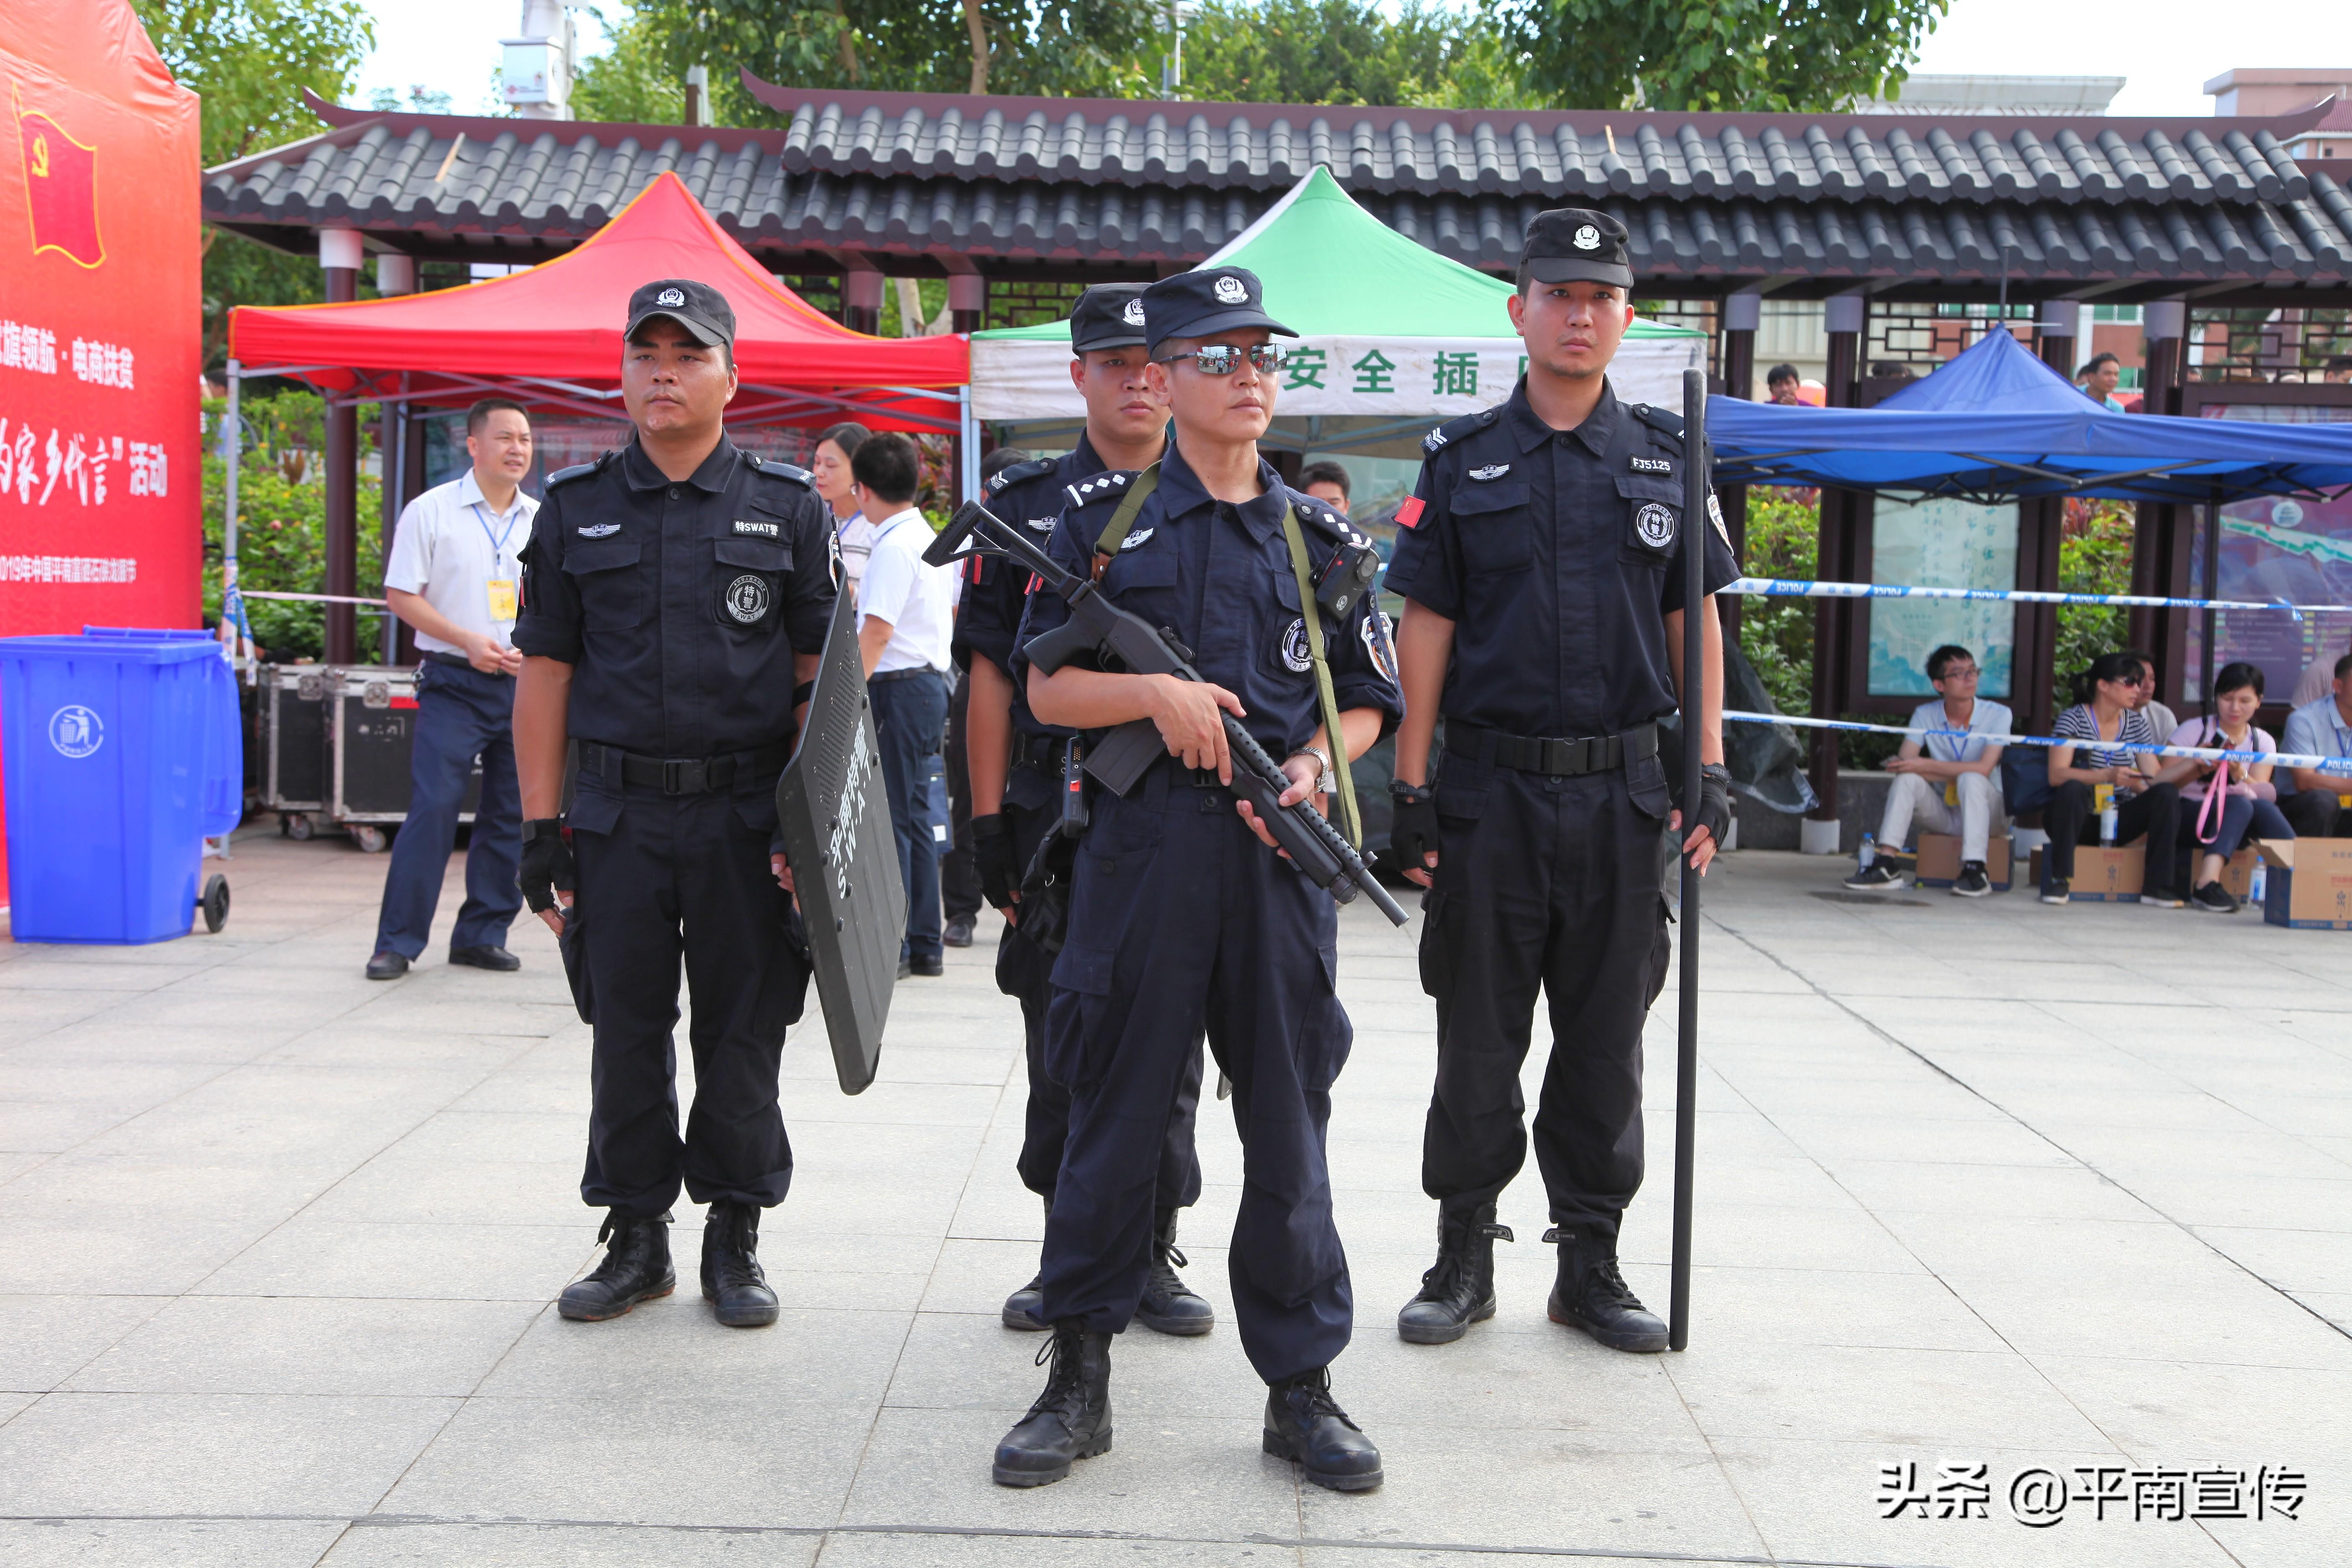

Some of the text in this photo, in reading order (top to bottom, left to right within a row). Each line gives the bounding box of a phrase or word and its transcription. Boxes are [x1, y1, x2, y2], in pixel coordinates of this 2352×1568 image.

[0, 320, 134, 390] 旗领航·电商扶贫
[1282, 346, 1529, 395] 安全插
[1633, 457, 1670, 471] FJ5125
[1651, 513, 1661, 535] 特警
[1646, 536, 1663, 544] SWAT
[1777, 583, 1804, 593] POLICE
[743, 585, 755, 609] 特警
[736, 611, 755, 620] SWAT
[1289, 660, 1307, 669] SWAT
[2226, 753, 2255, 762] POLICE
[2327, 758, 2352, 771] POLIC
